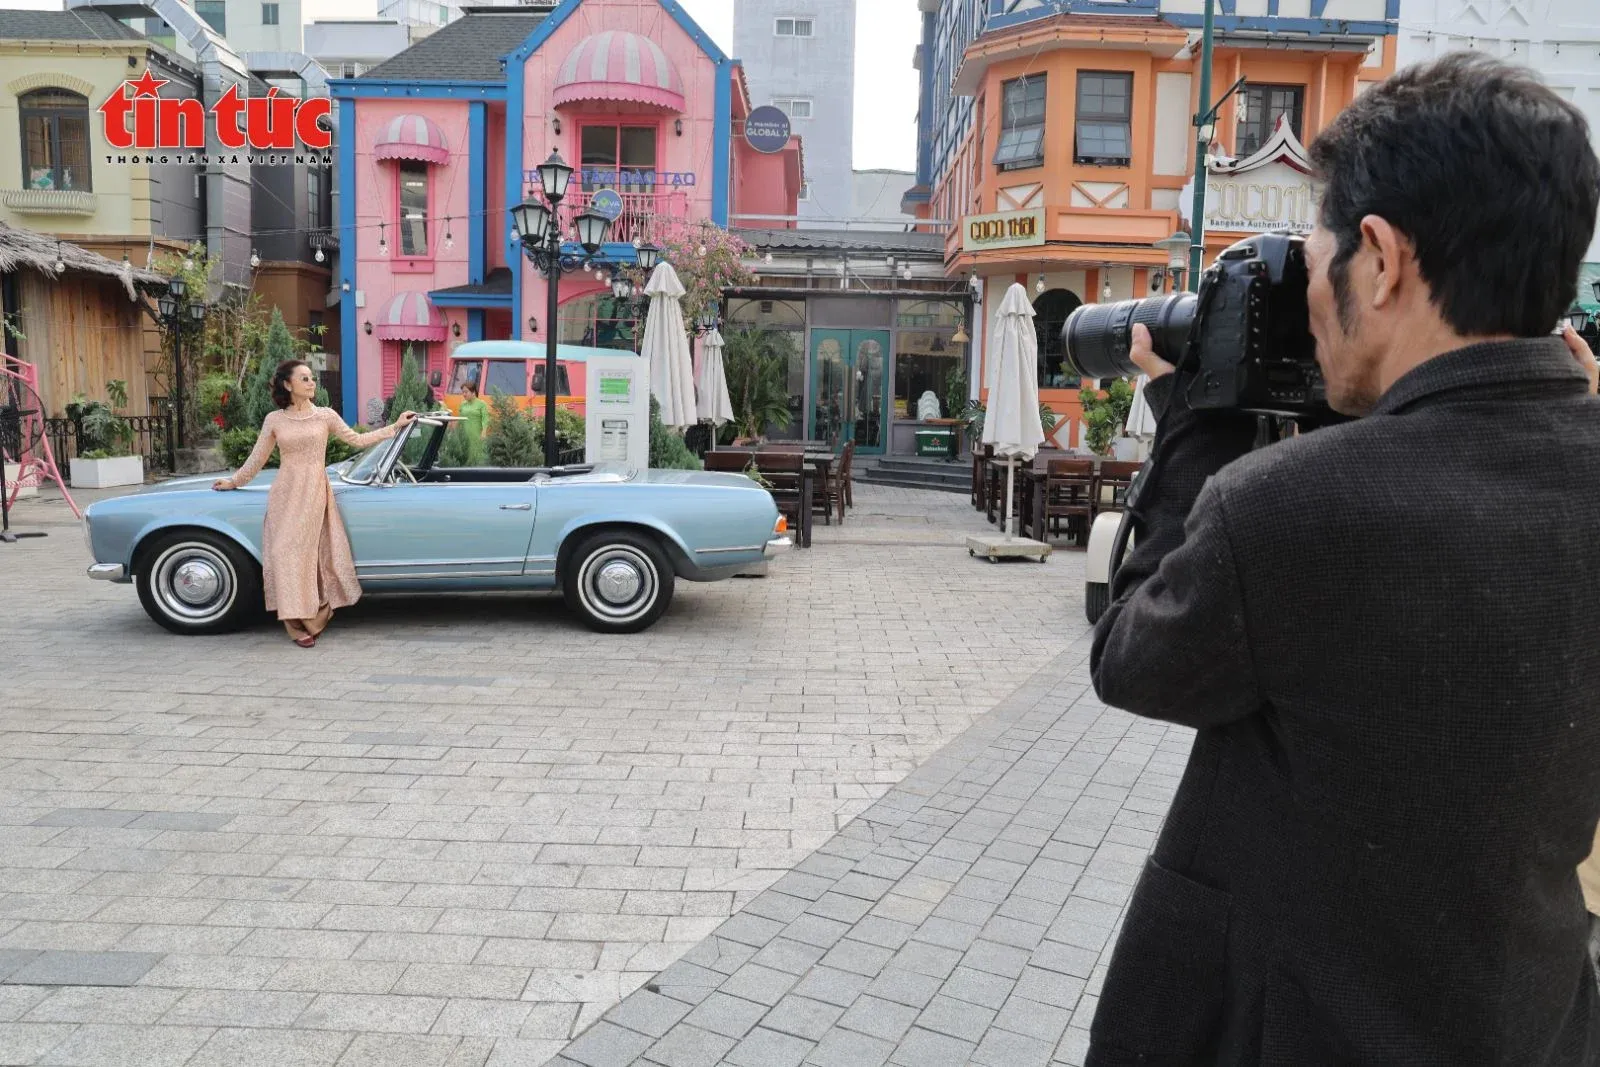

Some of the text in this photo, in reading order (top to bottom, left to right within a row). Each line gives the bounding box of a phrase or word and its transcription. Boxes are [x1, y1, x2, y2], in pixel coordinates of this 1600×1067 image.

[746, 128, 788, 138] GLOBAL X
[971, 219, 1004, 240] COCO
